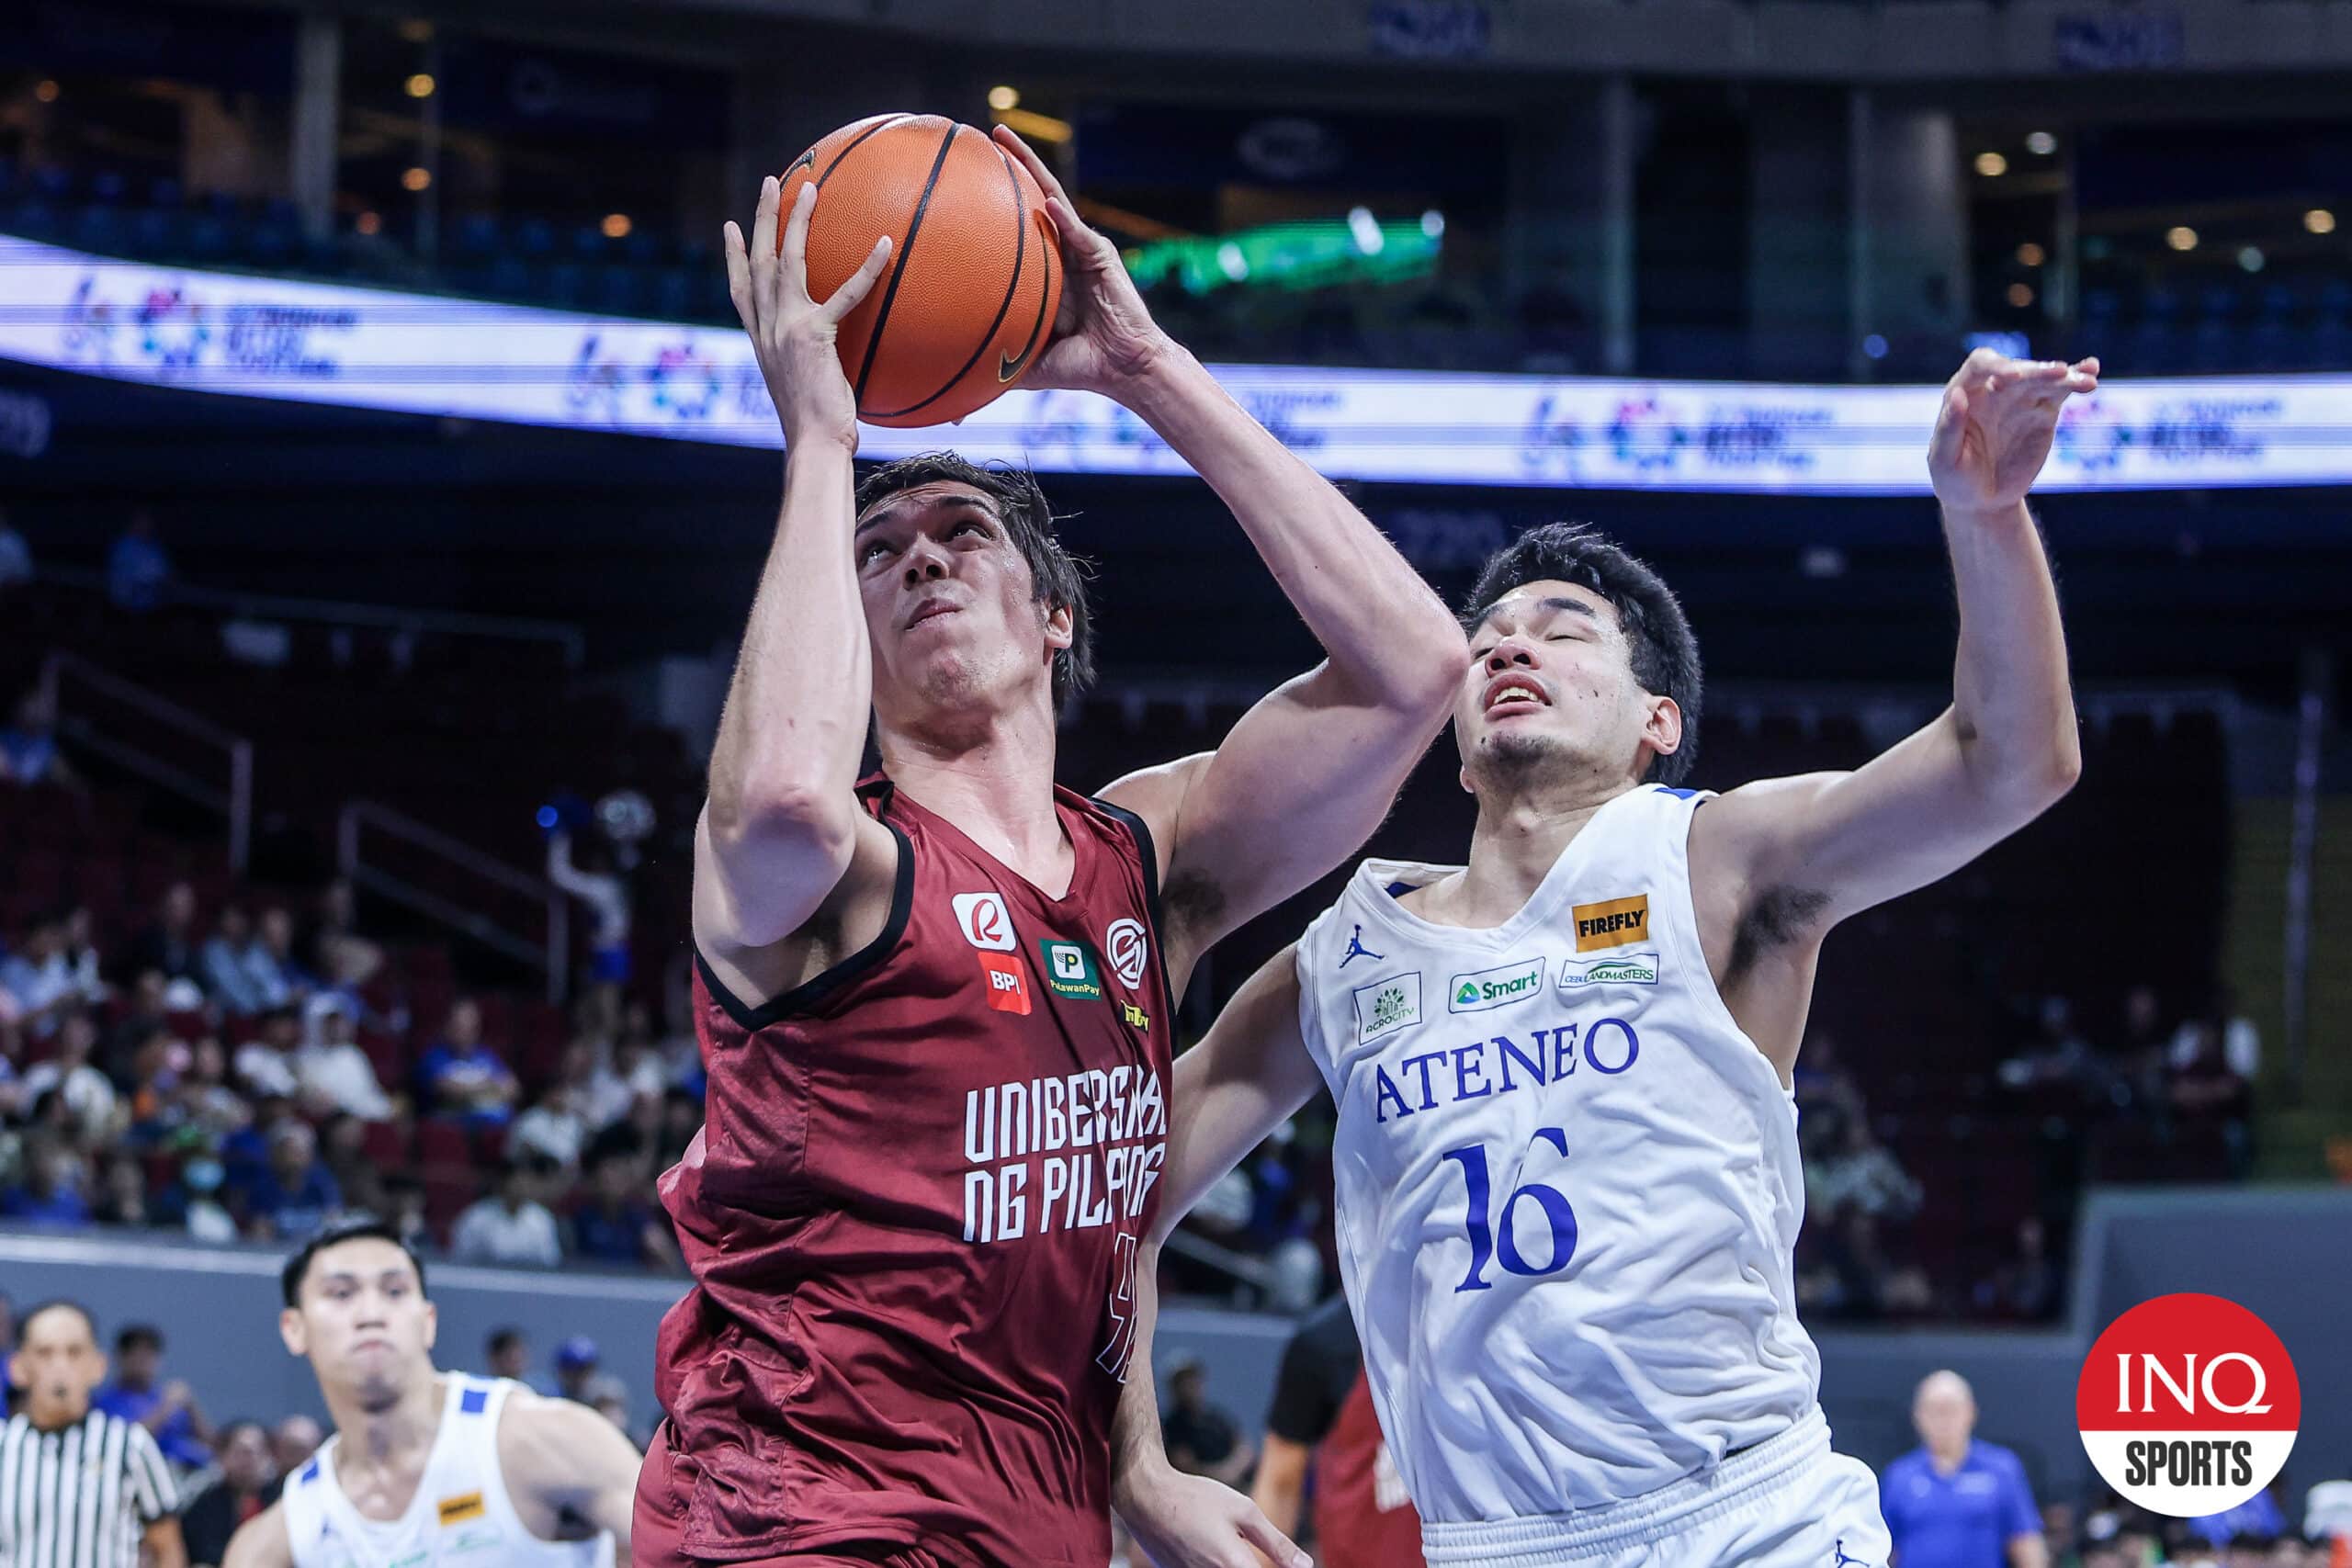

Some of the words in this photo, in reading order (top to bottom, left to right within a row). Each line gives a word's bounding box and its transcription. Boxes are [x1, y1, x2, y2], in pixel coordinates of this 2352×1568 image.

[1578, 909, 1644, 938] FIREFLY
[989, 970, 1021, 995] BPI
[1482, 970, 1538, 1001] Smart
[1584, 969, 1654, 983] LANDMASTERS
[1376, 1018, 1640, 1123] ATENEO
[963, 1162, 1027, 1243] NG
[1442, 1127, 1578, 1294] 16
